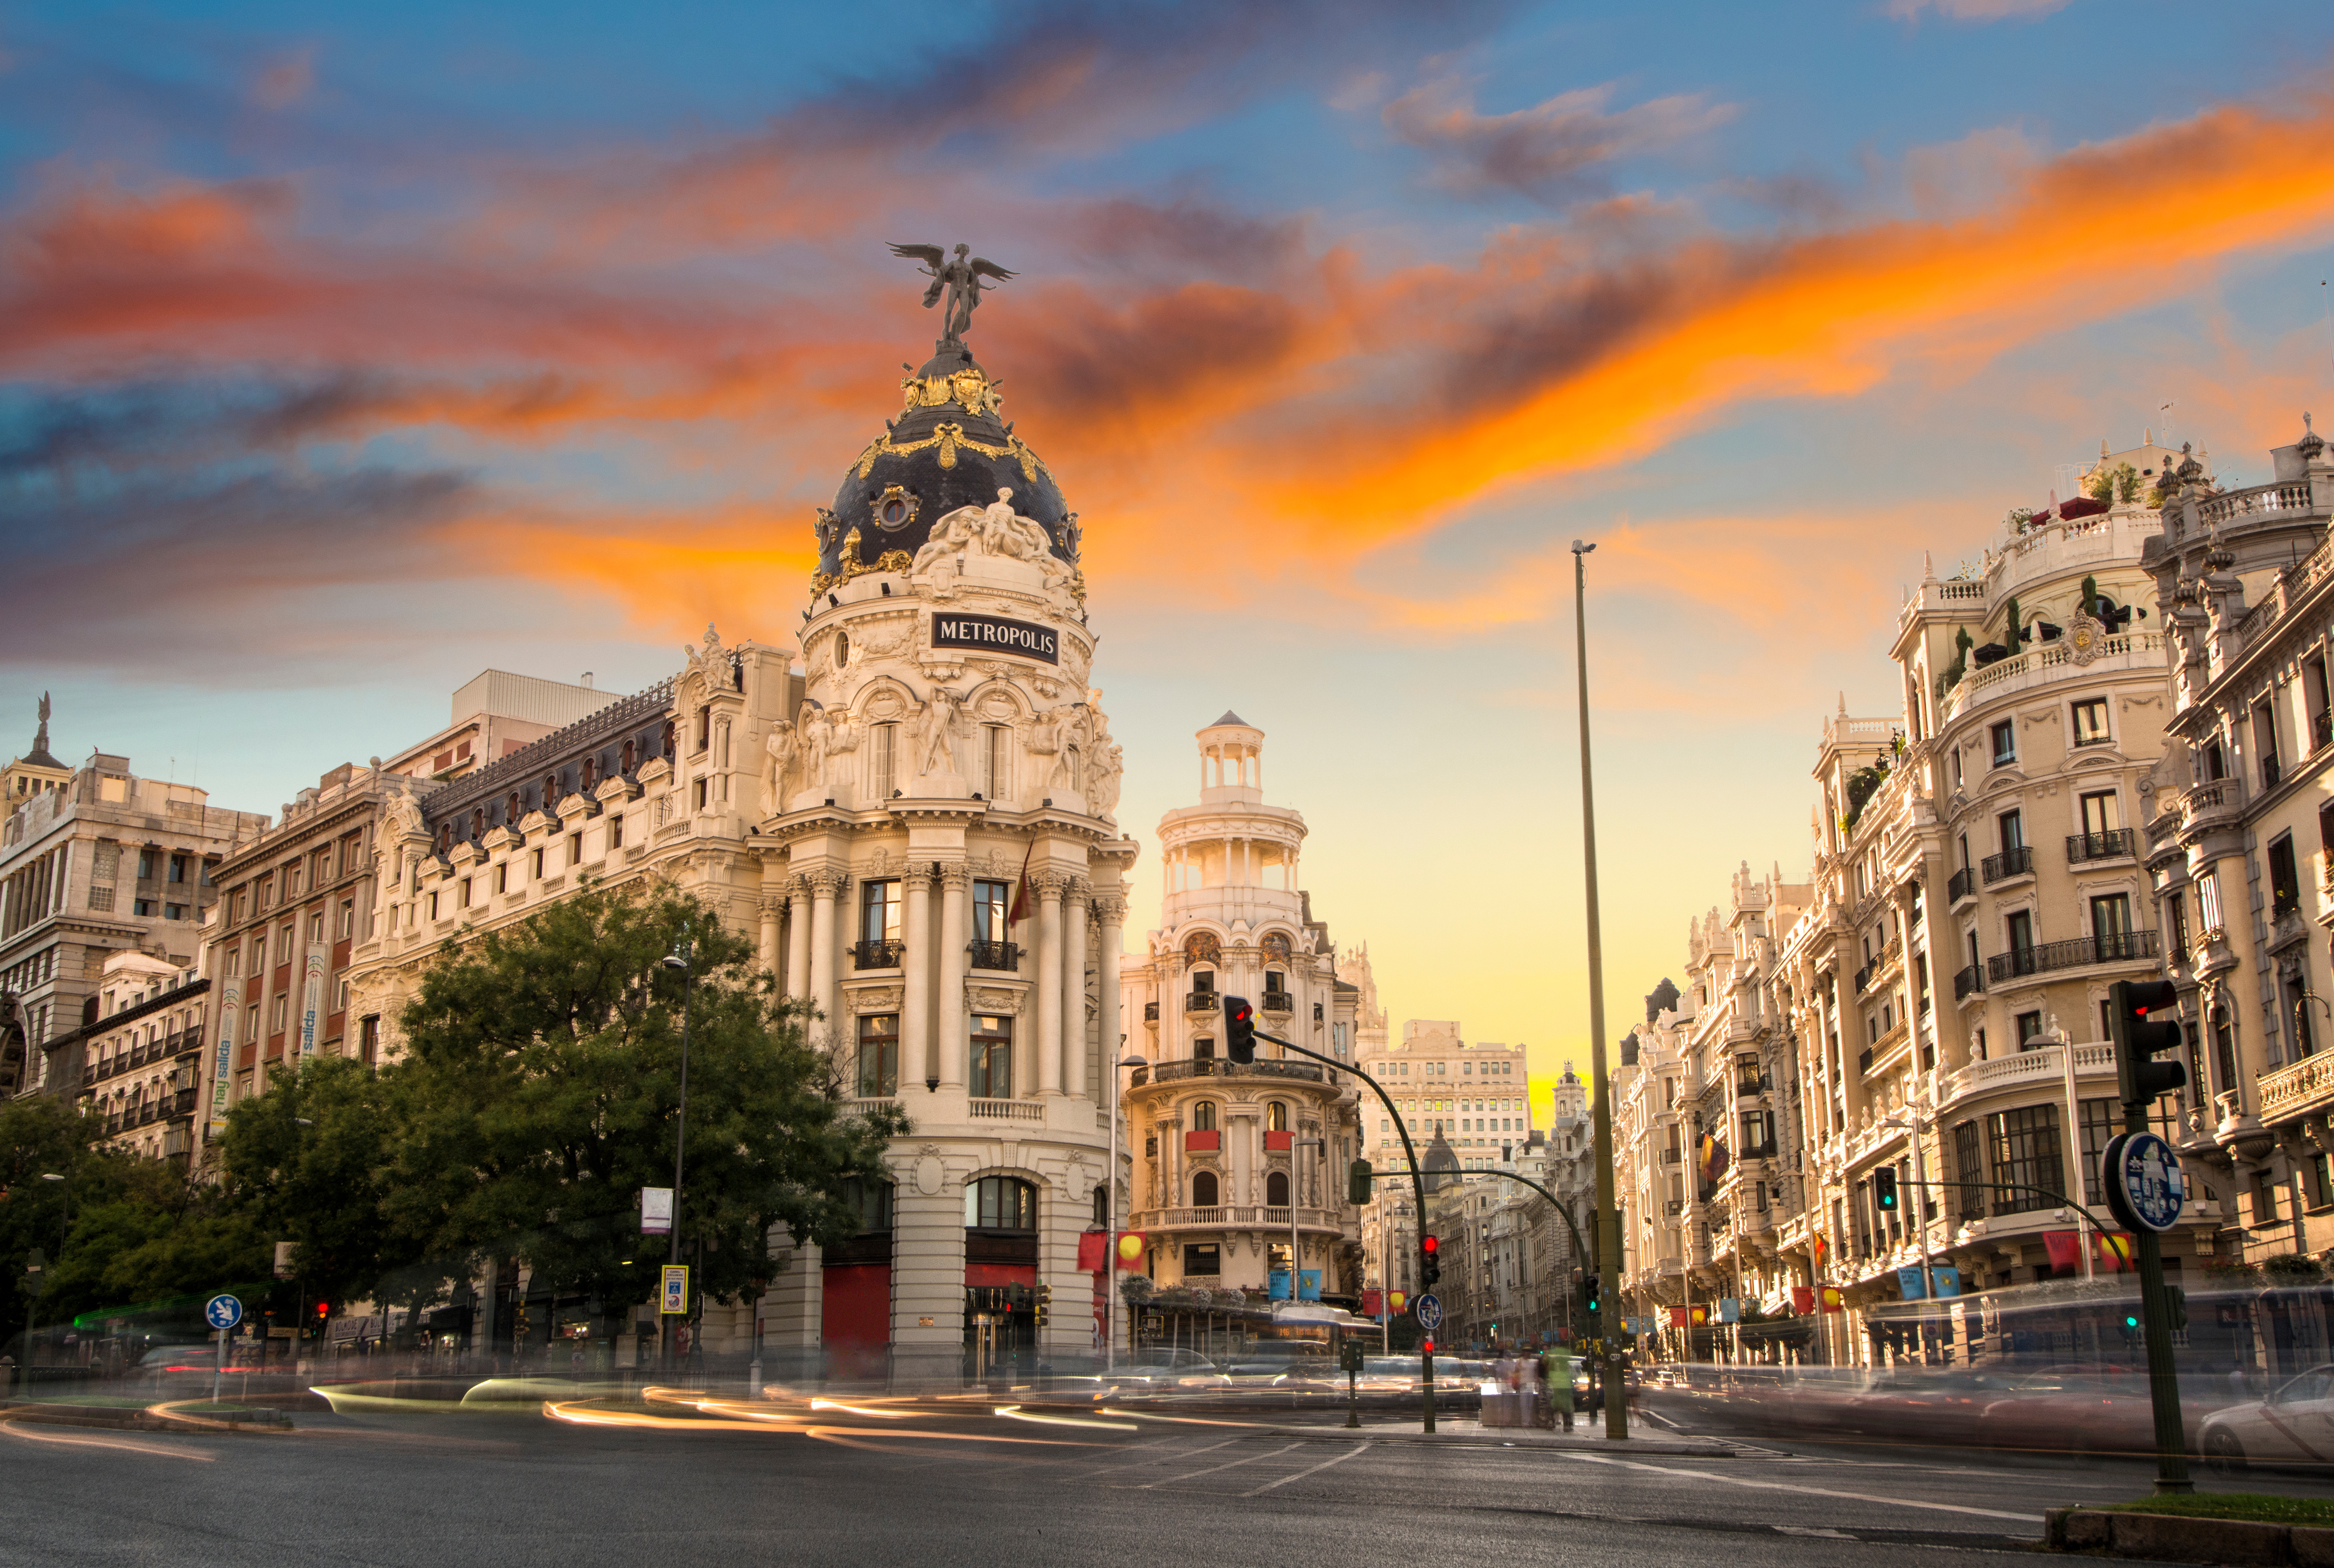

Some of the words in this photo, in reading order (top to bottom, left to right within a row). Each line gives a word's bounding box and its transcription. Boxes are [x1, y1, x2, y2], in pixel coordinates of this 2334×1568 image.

[941, 621, 1054, 654] METROPOLIS
[303, 1010, 316, 1051] salida
[217, 1040, 231, 1078] salida
[213, 1080, 230, 1105] hay
[1280, 1328, 1290, 1336] 146
